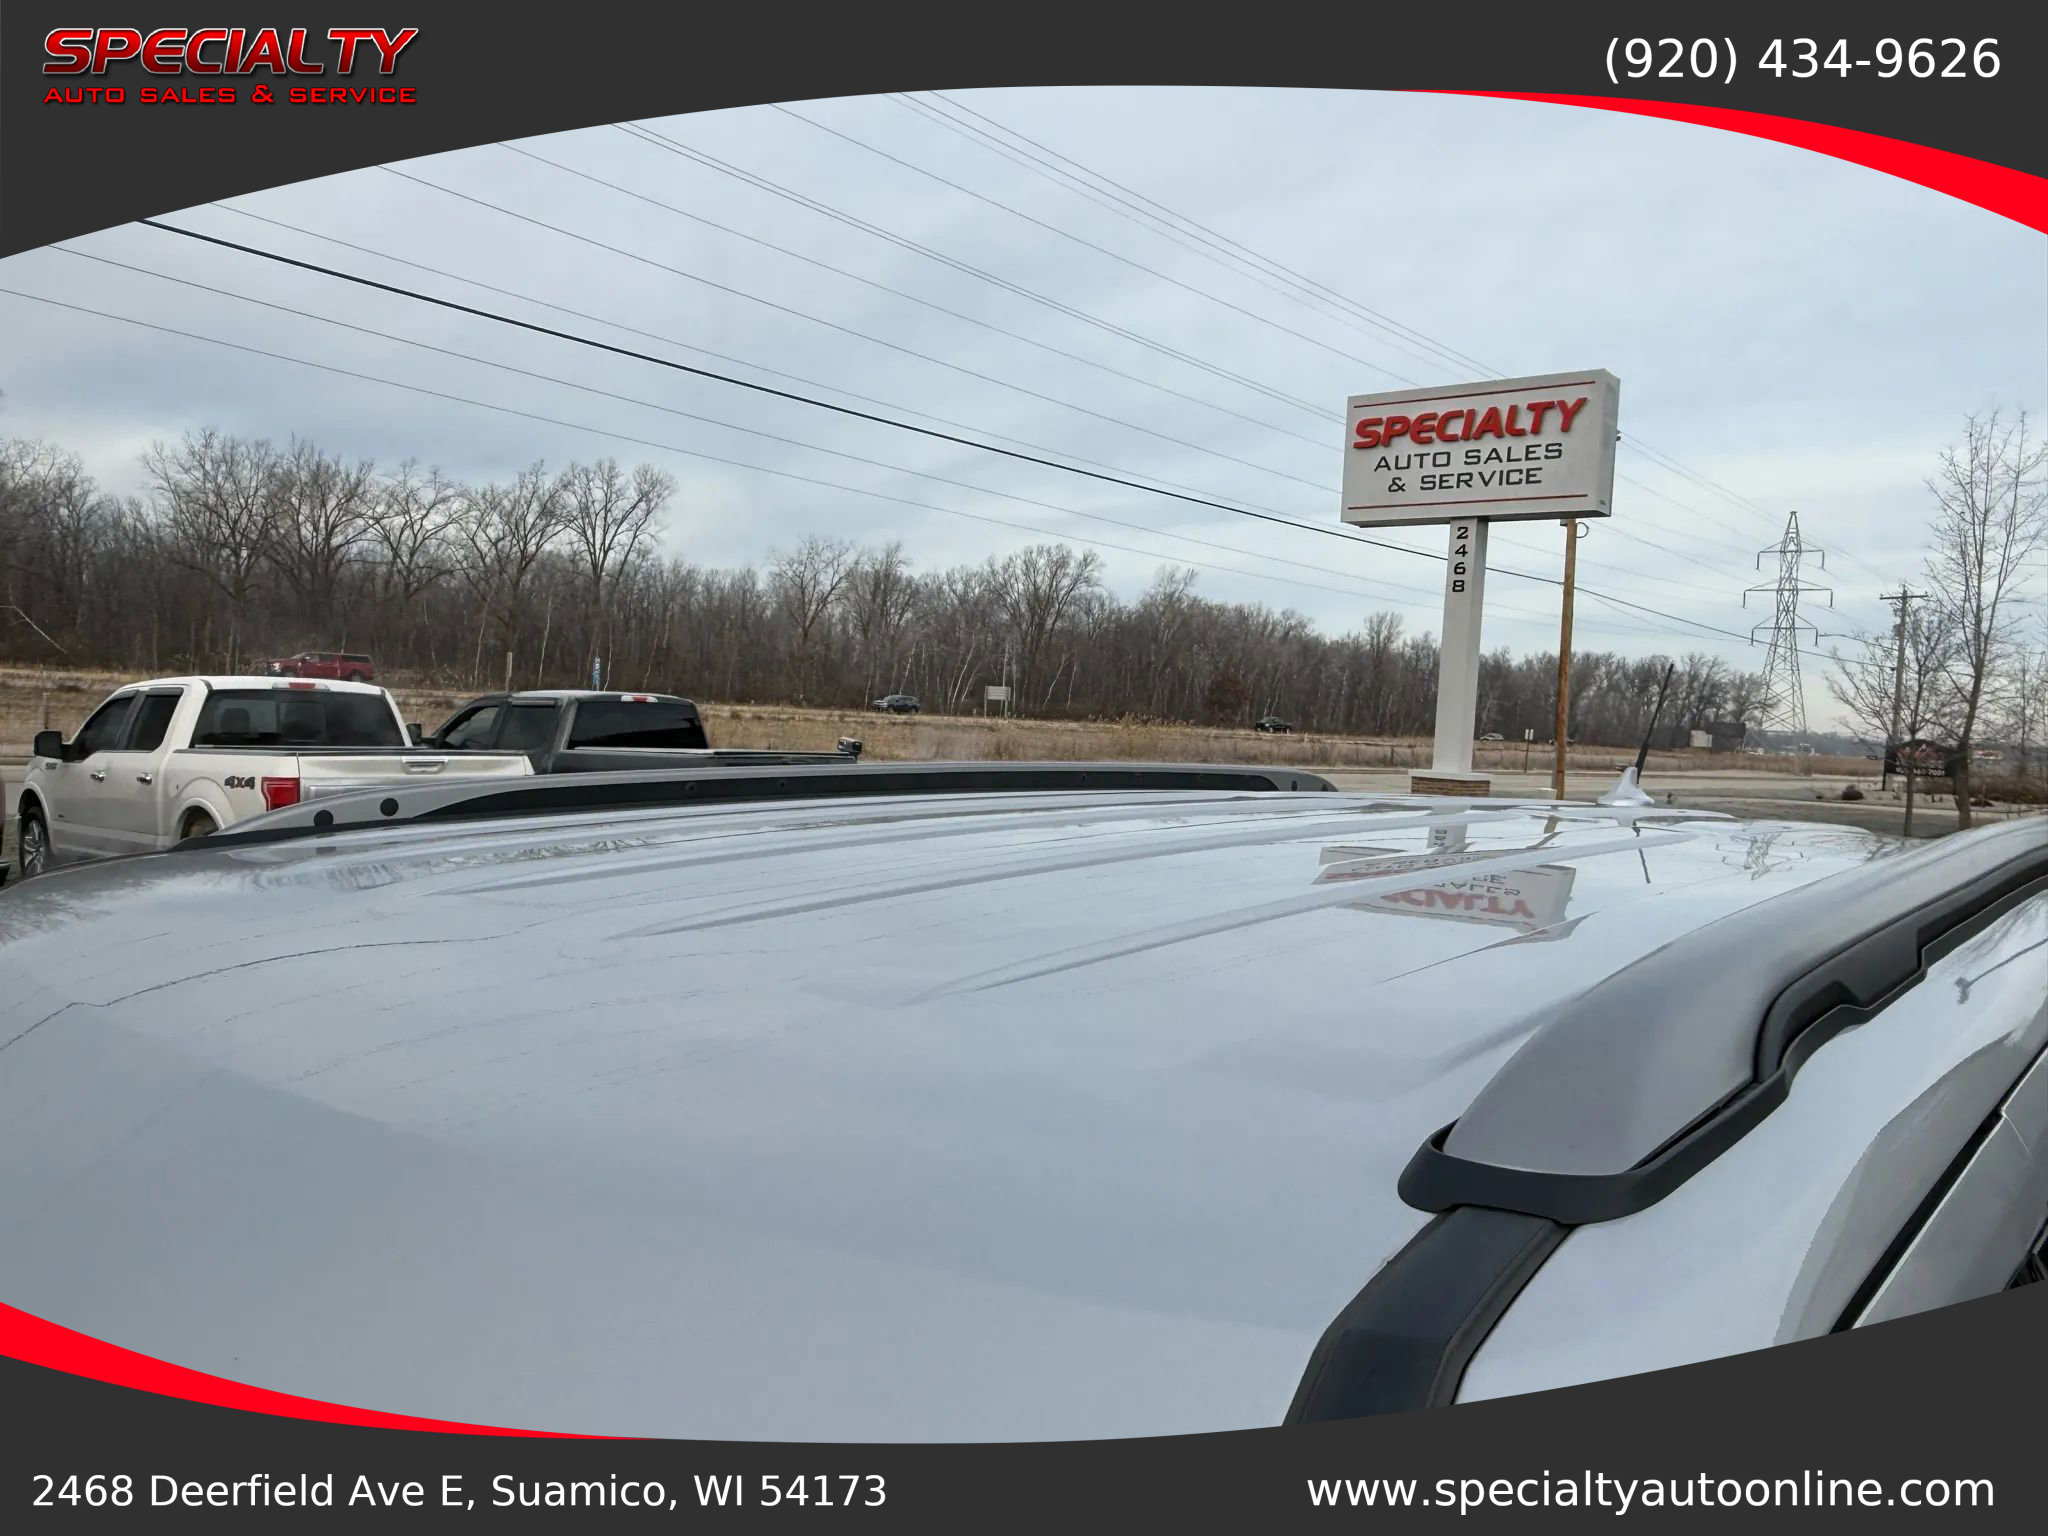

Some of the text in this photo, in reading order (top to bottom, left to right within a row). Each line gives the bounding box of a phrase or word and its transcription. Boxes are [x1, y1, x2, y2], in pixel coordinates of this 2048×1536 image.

[1353, 397, 1588, 450] SPECIALTY
[1374, 442, 1563, 472] AUTO SALES
[1388, 467, 1544, 493] & SERVICE
[1451, 526, 1469, 593] 2468
